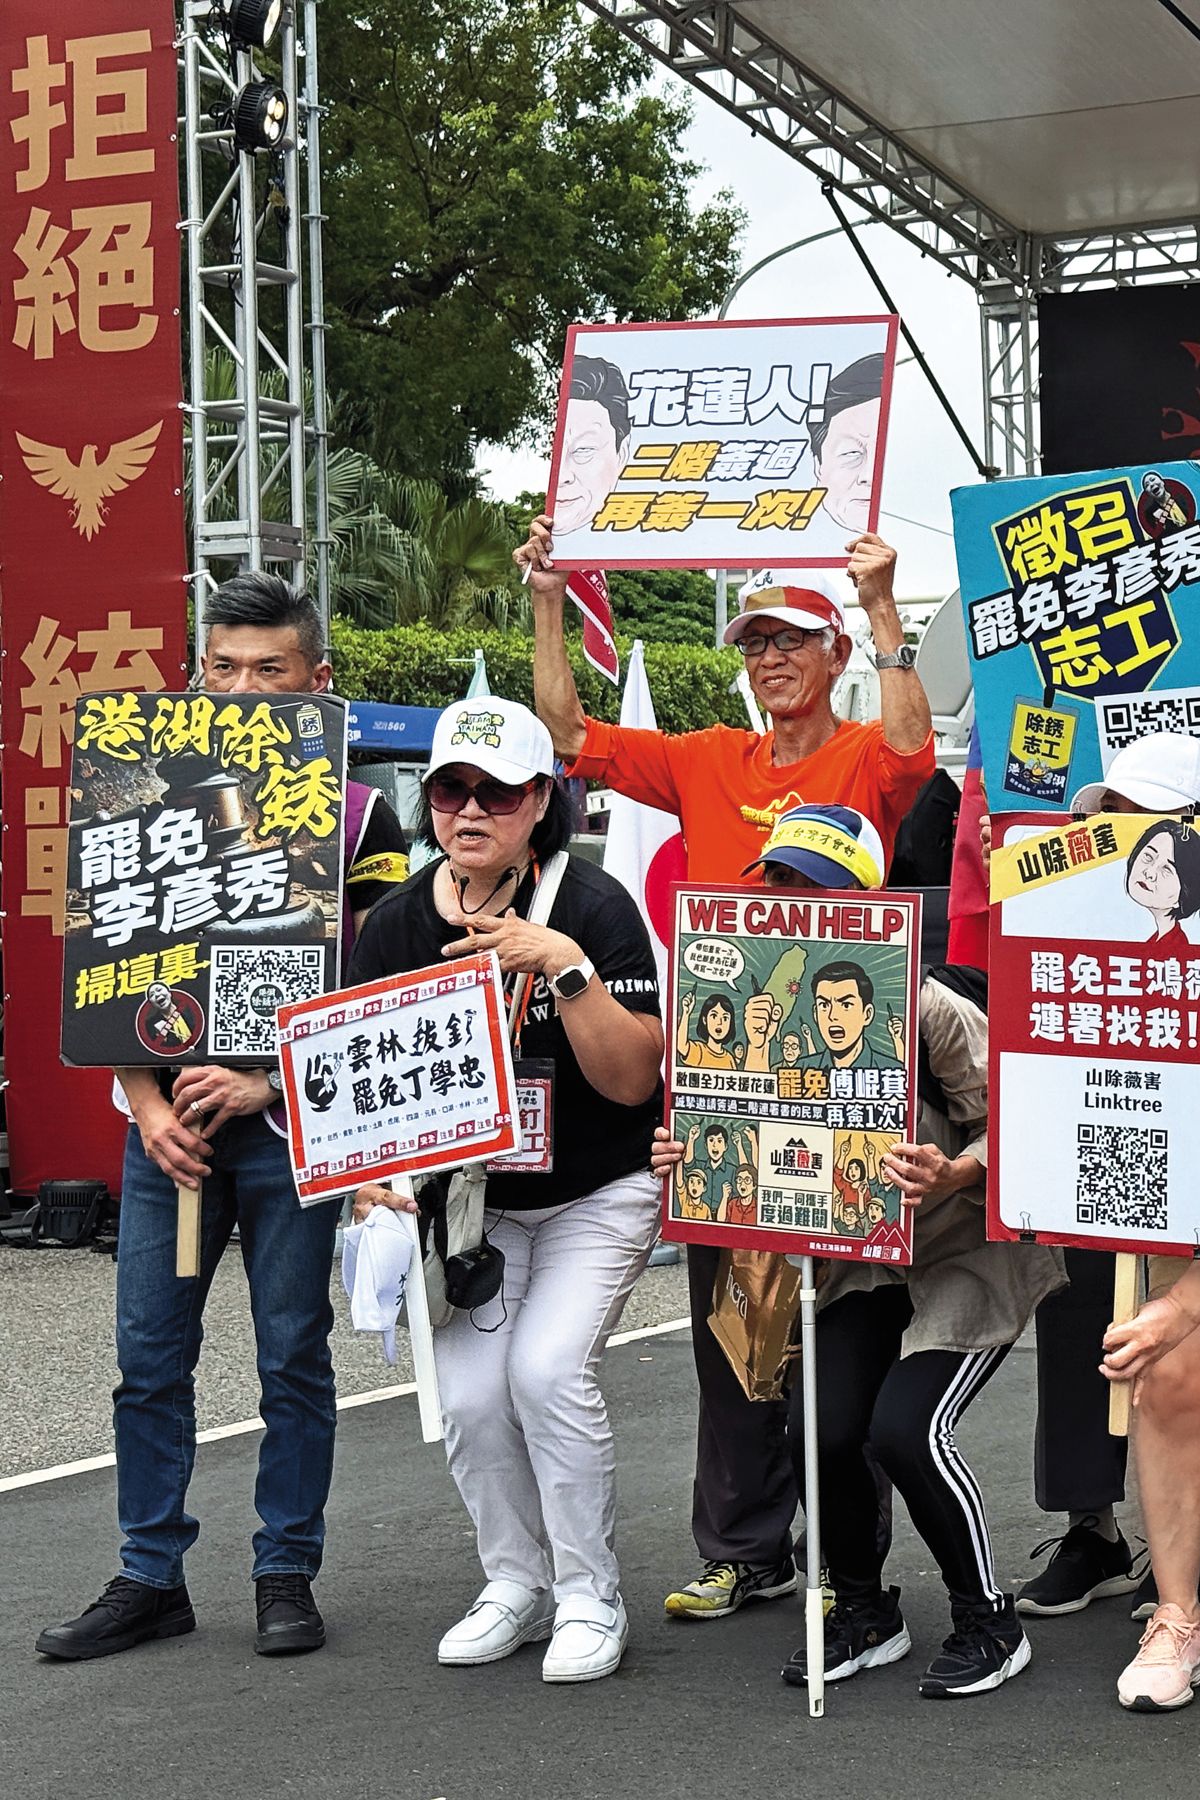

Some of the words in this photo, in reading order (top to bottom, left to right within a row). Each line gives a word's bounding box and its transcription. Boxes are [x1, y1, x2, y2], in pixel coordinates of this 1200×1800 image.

[11, 30, 159, 361] 拒絕
[628, 363, 832, 426] 花蓮人!
[619, 439, 809, 481] 二階簽過
[590, 488, 828, 532] 再簽一次!
[1005, 490, 1136, 584] 徵召
[1040, 600, 1172, 688] 志工
[1025, 711, 1065, 739] 除銹
[1022, 735, 1061, 760] 志工
[79, 807, 208, 889] 罷免
[1017, 822, 1119, 884] 山除薇害
[92, 849, 290, 948] 李彥秀
[687, 898, 737, 933] WE
[744, 902, 812, 938] CAN
[818, 905, 904, 941] HELP
[1029, 1002, 1199, 1049] 連署找我!
[352, 1054, 486, 1116] 罷免丁學忠
[1086, 1068, 1162, 1091] 山除薇害
[826, 1103, 905, 1129] 再簽1次!
[1084, 1091, 1163, 1113] Linktree
[770, 1149, 823, 1170] 山除薇害
[760, 1203, 828, 1229] 度過難關
[761, 1189, 828, 1208] 我們一同攜手
